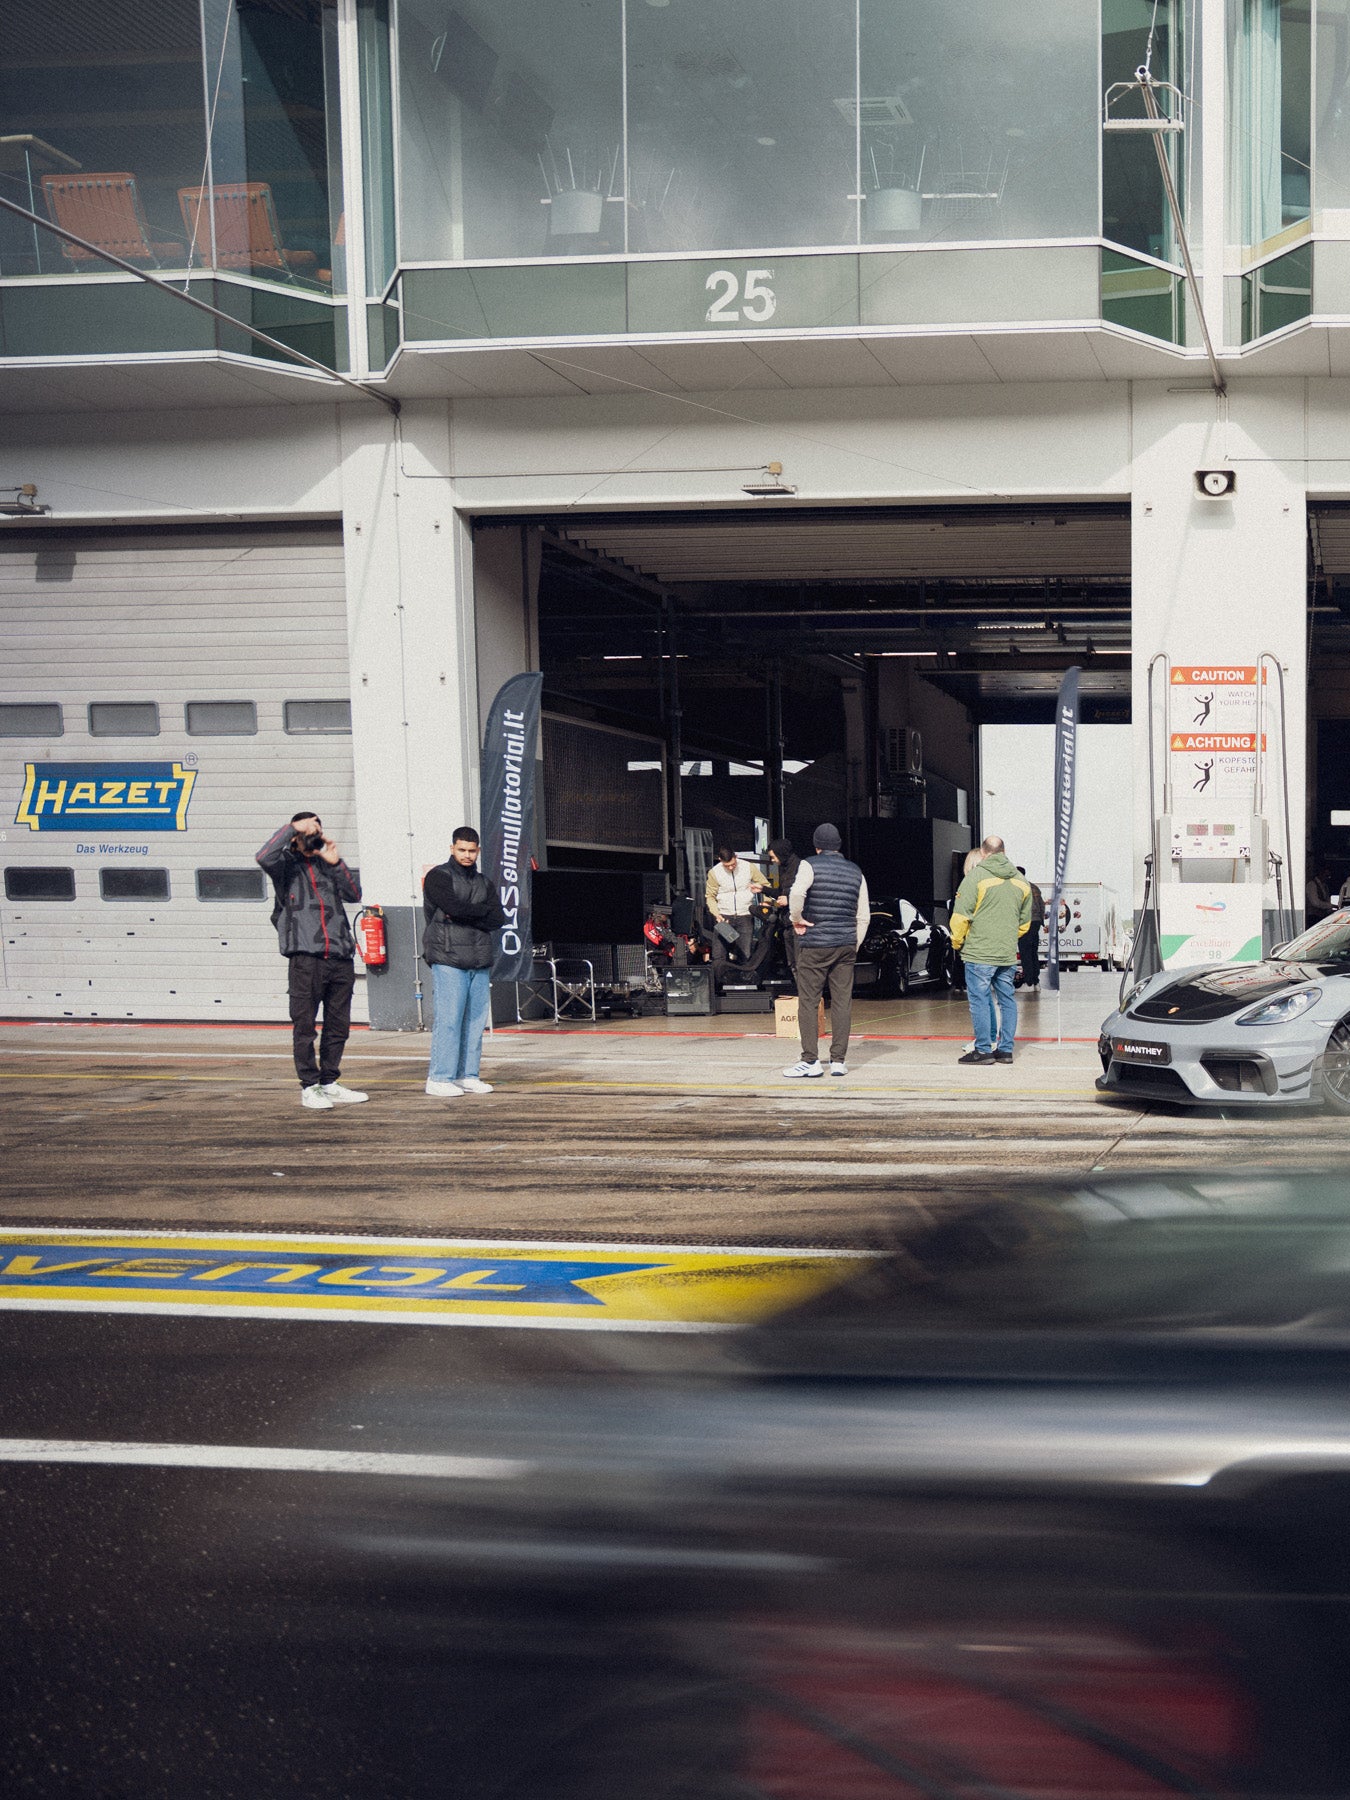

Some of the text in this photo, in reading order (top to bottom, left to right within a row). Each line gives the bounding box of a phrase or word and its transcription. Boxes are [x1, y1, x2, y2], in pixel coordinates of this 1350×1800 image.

[705, 269, 777, 322] 25
[1191, 670, 1245, 681] CAUTION
[1186, 736, 1251, 748] ACHTUNG
[34, 780, 178, 814] HAZET
[76, 844, 149, 855] Das Werkzeug
[1208, 950, 1222, 960] 98
[1124, 1045, 1162, 1056] MANTHEY
[0, 1256, 526, 1291] VENOL
